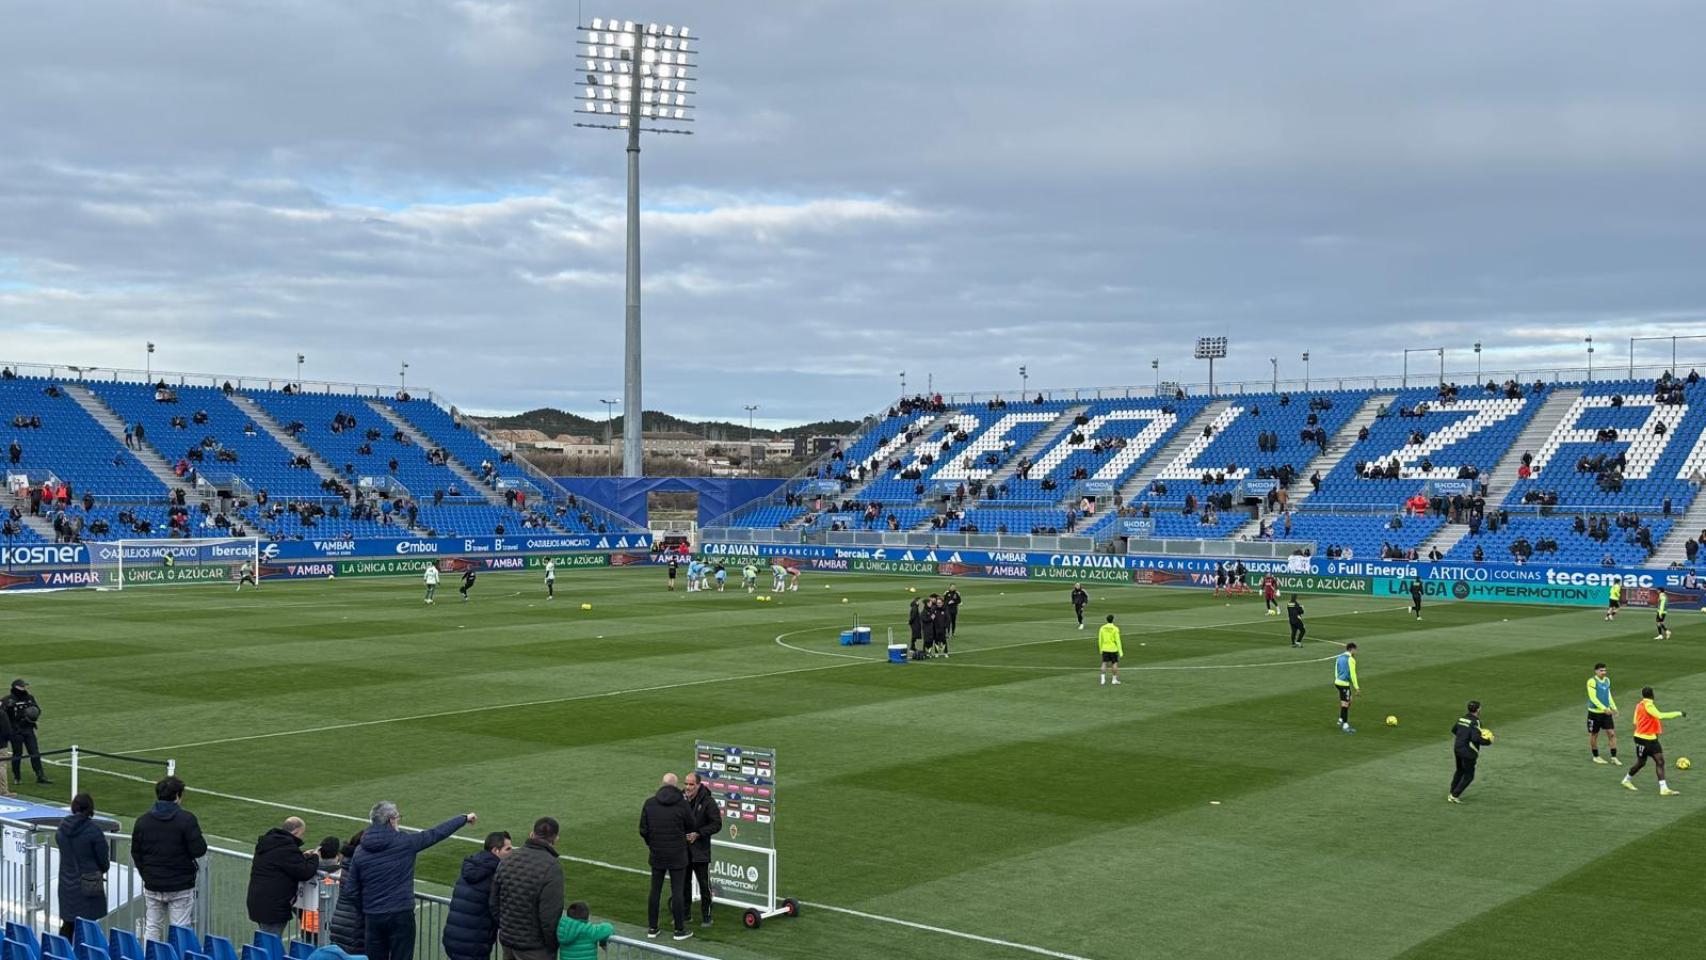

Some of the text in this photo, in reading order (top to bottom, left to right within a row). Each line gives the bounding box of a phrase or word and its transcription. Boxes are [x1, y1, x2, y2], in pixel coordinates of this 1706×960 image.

[320, 541, 356, 551] AMBAR
[396, 541, 438, 554] embou
[704, 544, 825, 557] CARAVAN FRAGANCIAS
[493, 558, 524, 568] AMBAR
[530, 557, 540, 567] LA
[995, 552, 1028, 562] AMBAR
[1050, 555, 1126, 568] CARAVAN
[297, 563, 335, 576] AMBAR
[341, 563, 355, 574] LA
[357, 560, 386, 573] ÚNICA
[818, 559, 848, 569] AMBAR
[853, 560, 865, 570] LA
[1338, 562, 1418, 579] Full Energía
[52, 572, 100, 584] AMBAR
[178, 567, 224, 580] AZÚCAR
[993, 566, 1028, 577] AMBAR
[1034, 568, 1047, 577] LA
[1089, 568, 1129, 581] AZÚCAR
[1428, 566, 1541, 581] ARTICO COCINAS
[1546, 568, 1653, 588] tecemac
[1317, 577, 1366, 591] AZÚCAR
[1473, 585, 1588, 600] HYPERMOTION
